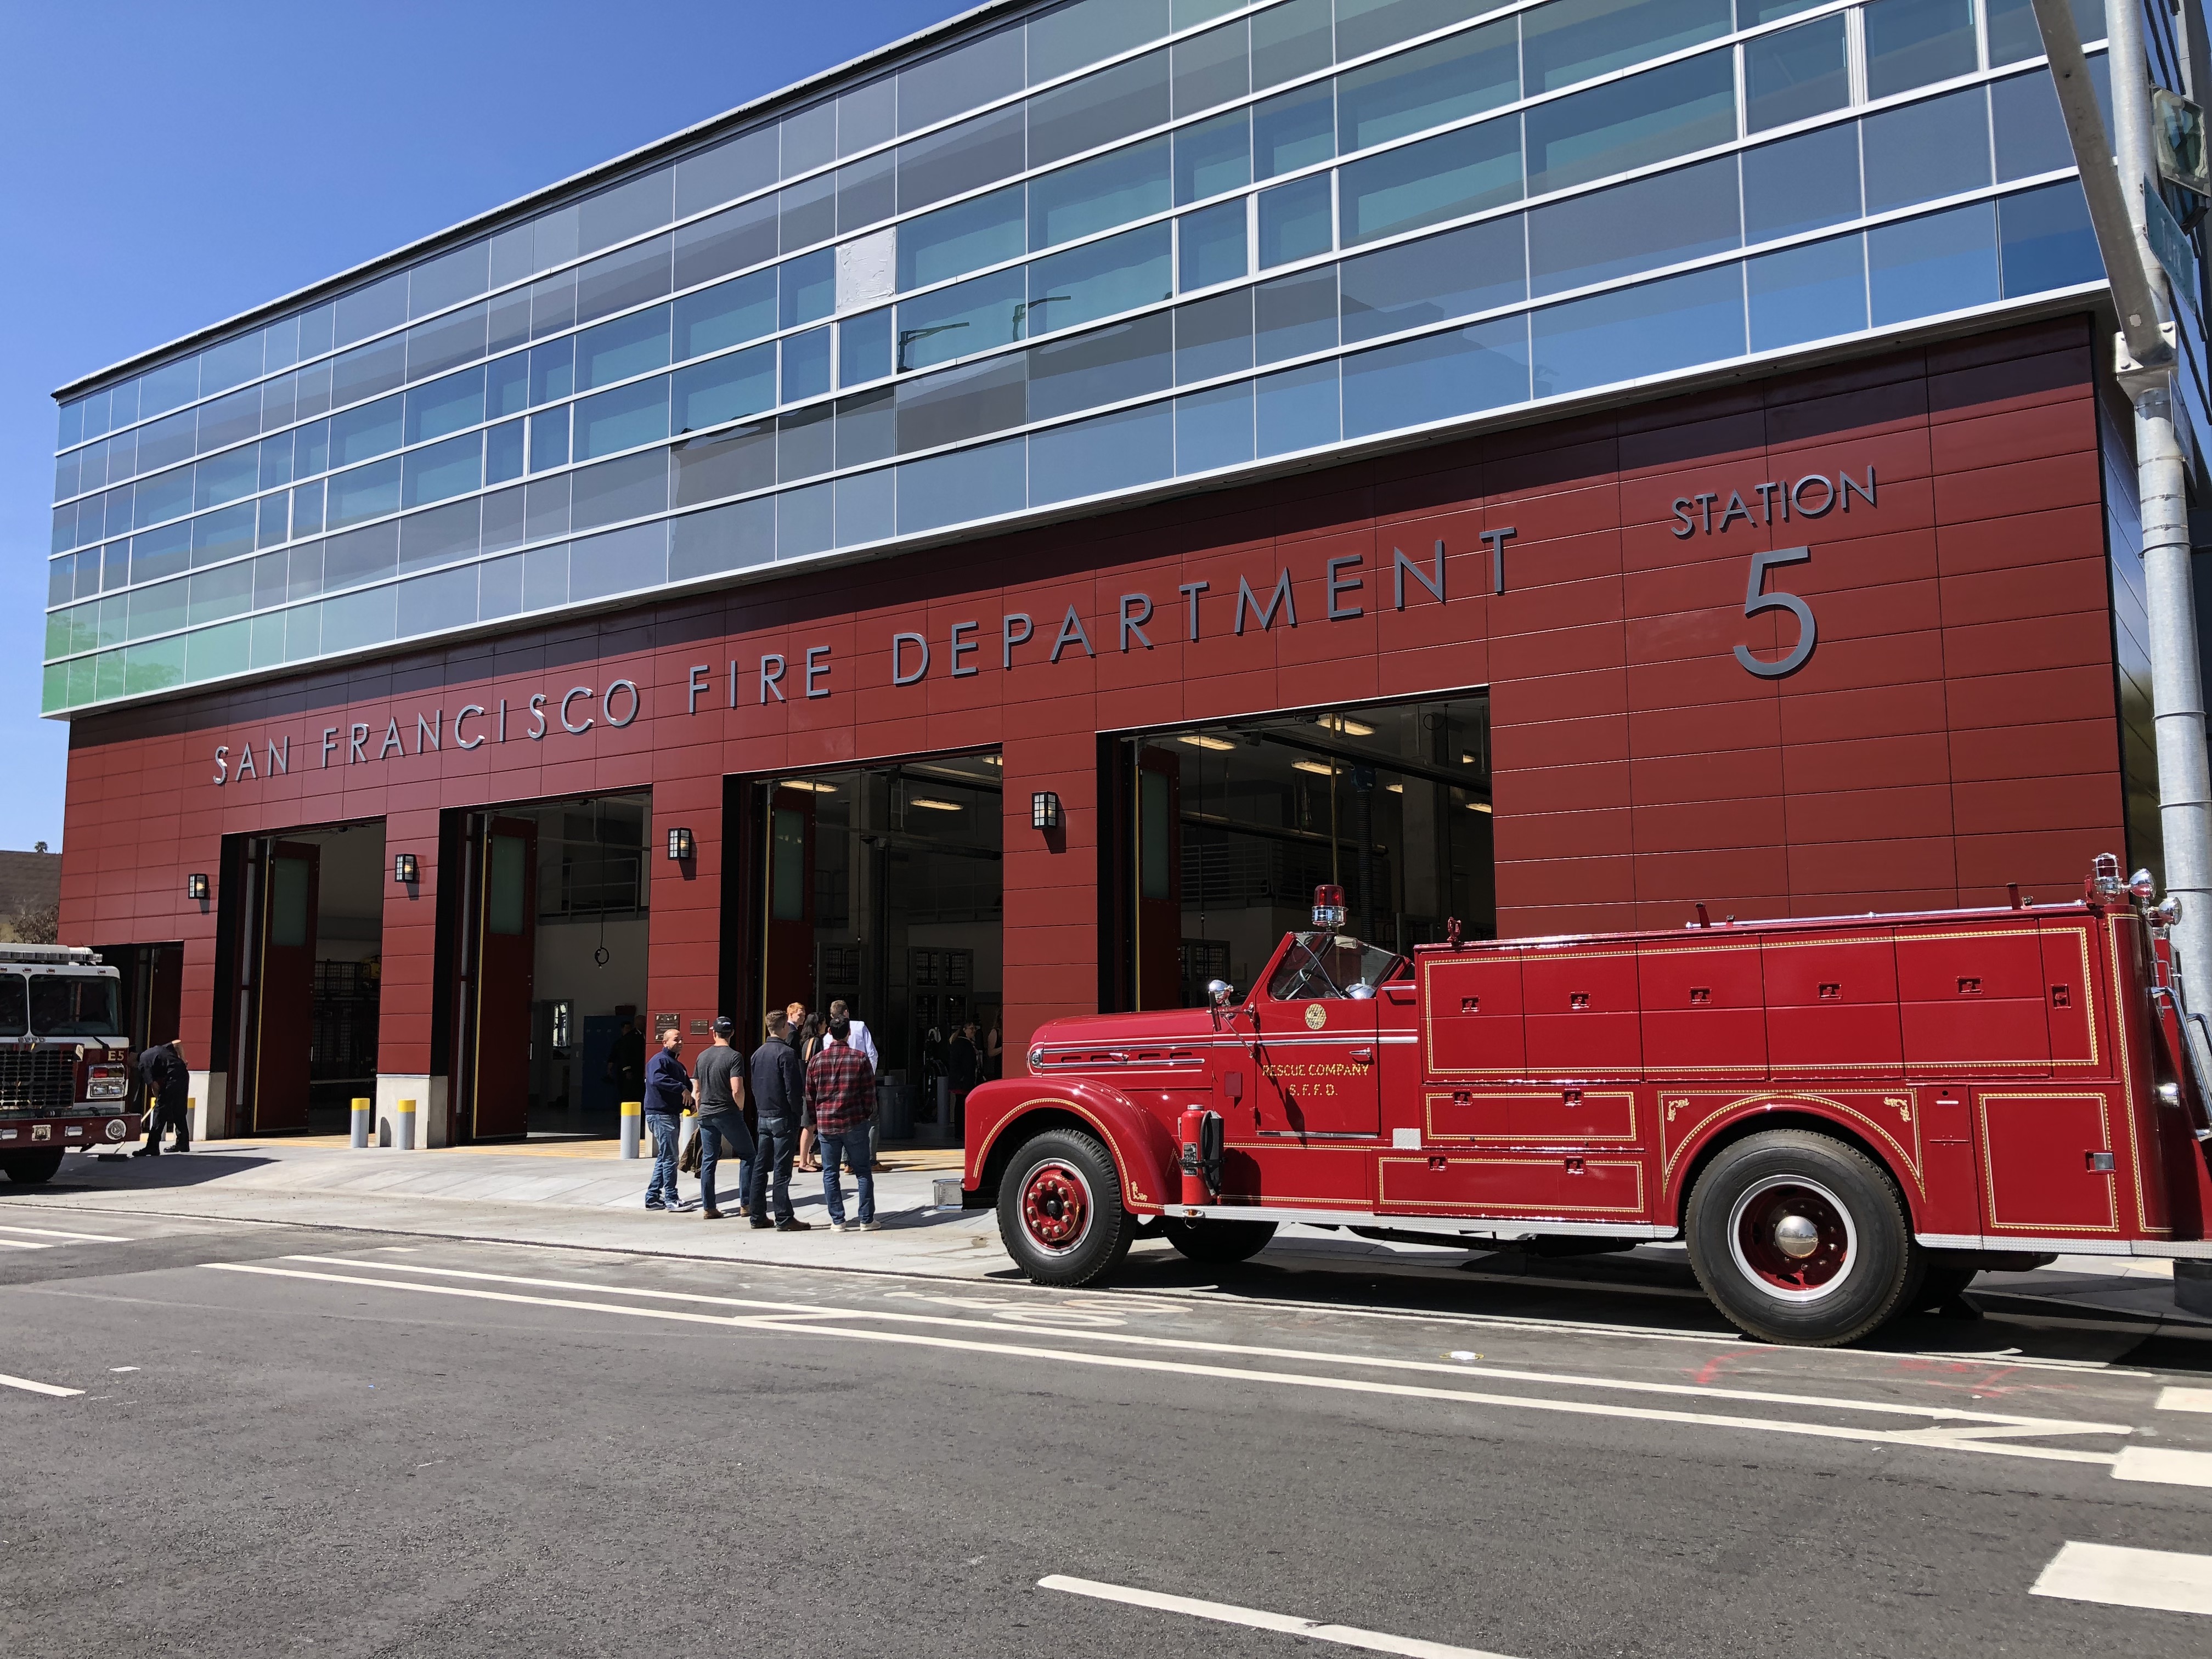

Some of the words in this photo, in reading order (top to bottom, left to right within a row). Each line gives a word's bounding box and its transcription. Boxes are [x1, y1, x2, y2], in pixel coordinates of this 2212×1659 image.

[1671, 465, 1876, 536] STATION
[1733, 545, 1816, 676] 5
[213, 735, 289, 785] SAN
[321, 679, 639, 768] FRANCISCO
[689, 645, 831, 714] FIRE
[893, 527, 1516, 686] DEPARTMENT
[108, 1051, 124, 1061] E5
[1262, 1064, 1306, 1076] RESCUE
[1308, 1064, 1369, 1076] COMPANY
